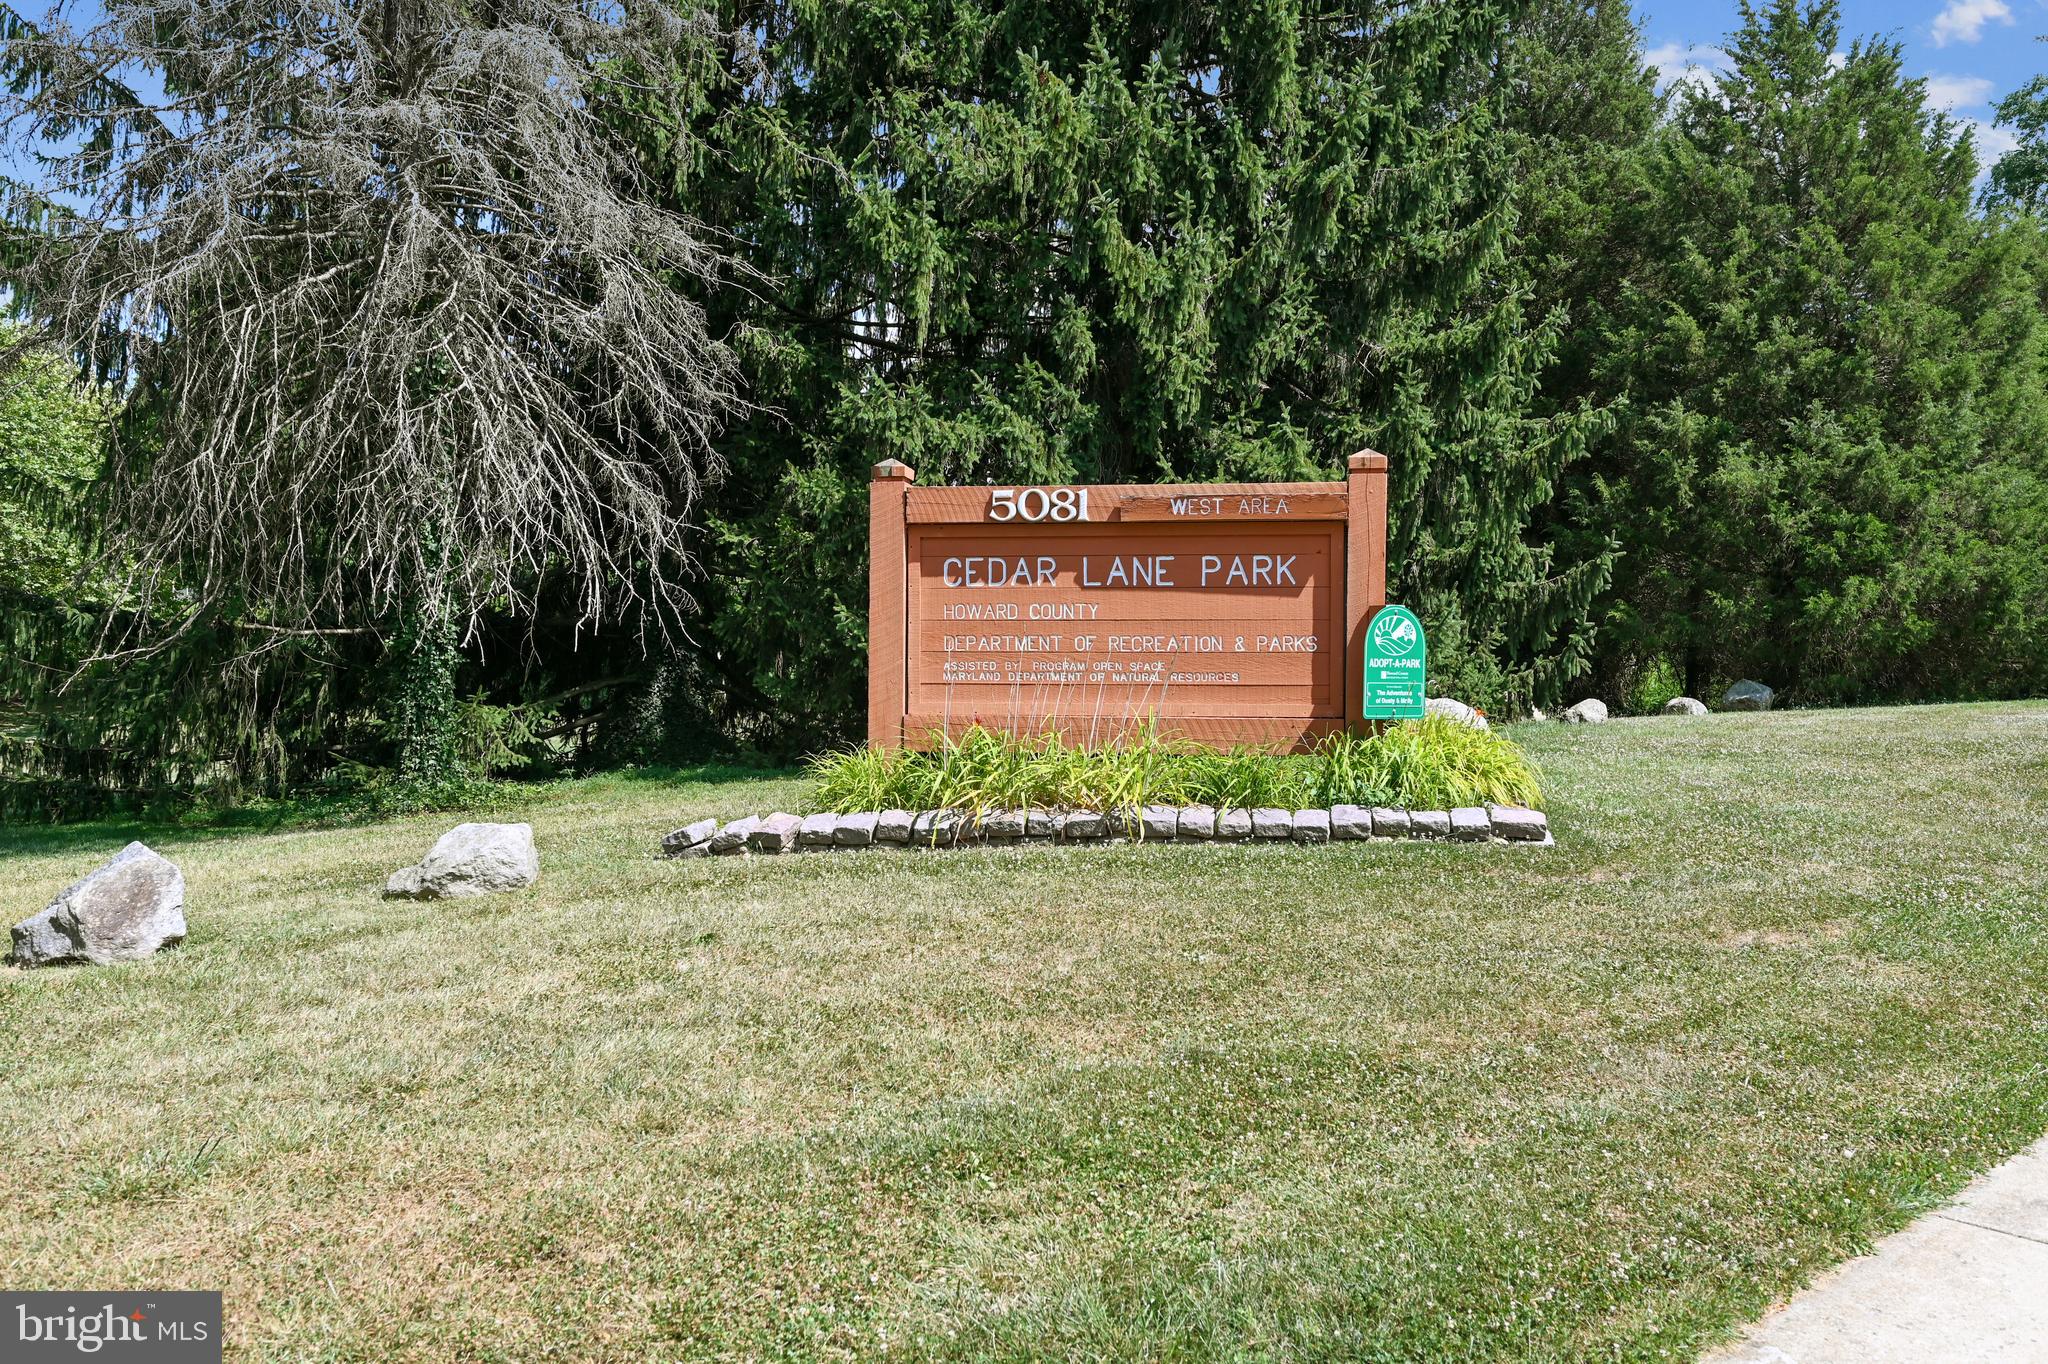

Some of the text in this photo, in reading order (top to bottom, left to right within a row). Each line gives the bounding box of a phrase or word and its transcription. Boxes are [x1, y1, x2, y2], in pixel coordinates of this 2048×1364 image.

[990, 488, 1090, 521] 5081
[1170, 497, 1289, 515] WEST AREA
[943, 555, 1297, 587] CEDAR LANE PARK
[943, 603, 1099, 620] HOWARD COUNTY
[943, 635, 1318, 652] DEPARTMENT OF RECREATION & PARKS
[943, 661, 1166, 671] ASSISTED BY PROGRAM OPEN SPACE
[1369, 658, 1421, 668] ADOPT-A-PARK
[943, 672, 1240, 682] MARYLAND DEPARTMENT OF NATURAL RESOURCES
